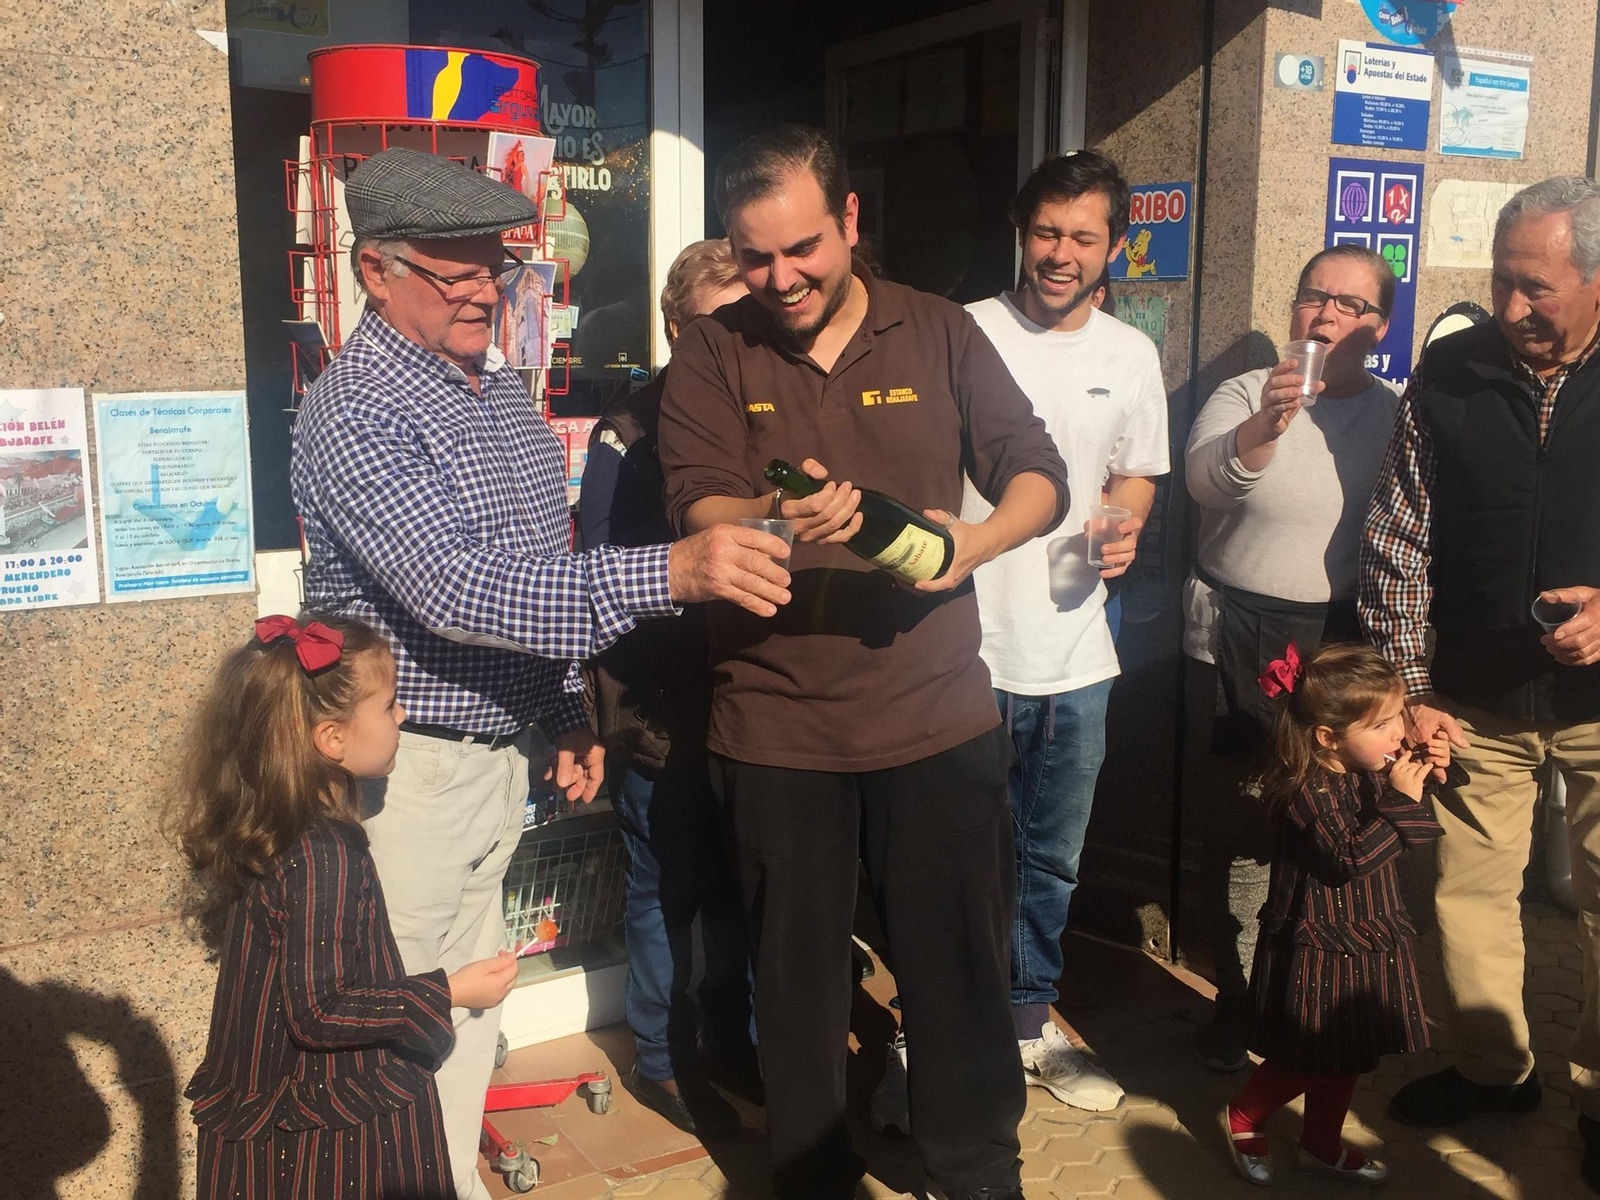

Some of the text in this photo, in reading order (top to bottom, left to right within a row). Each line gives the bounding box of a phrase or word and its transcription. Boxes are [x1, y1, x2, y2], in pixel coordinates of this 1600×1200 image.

[1300, 65, 1313, 75] +18
[1392, 60, 1397, 69] y
[1364, 68, 1428, 83] Apuestas del Estado
[541, 84, 597, 134] MAYOR
[582, 131, 605, 166] ES
[1381, 353, 1391, 373] y
[110, 406, 232, 417] Clases de Técnicas Corporales
[29, 417, 66, 431] BELÉN
[149, 425, 192, 435] Benajarafe
[189, 500, 218, 509] Octubre
[4, 553, 83, 570] 17:00 A 20:00
[4, 568, 72, 582] MERENDERO
[0, 584, 39, 595] RUENO
[26, 593, 59, 604] LIBRE
